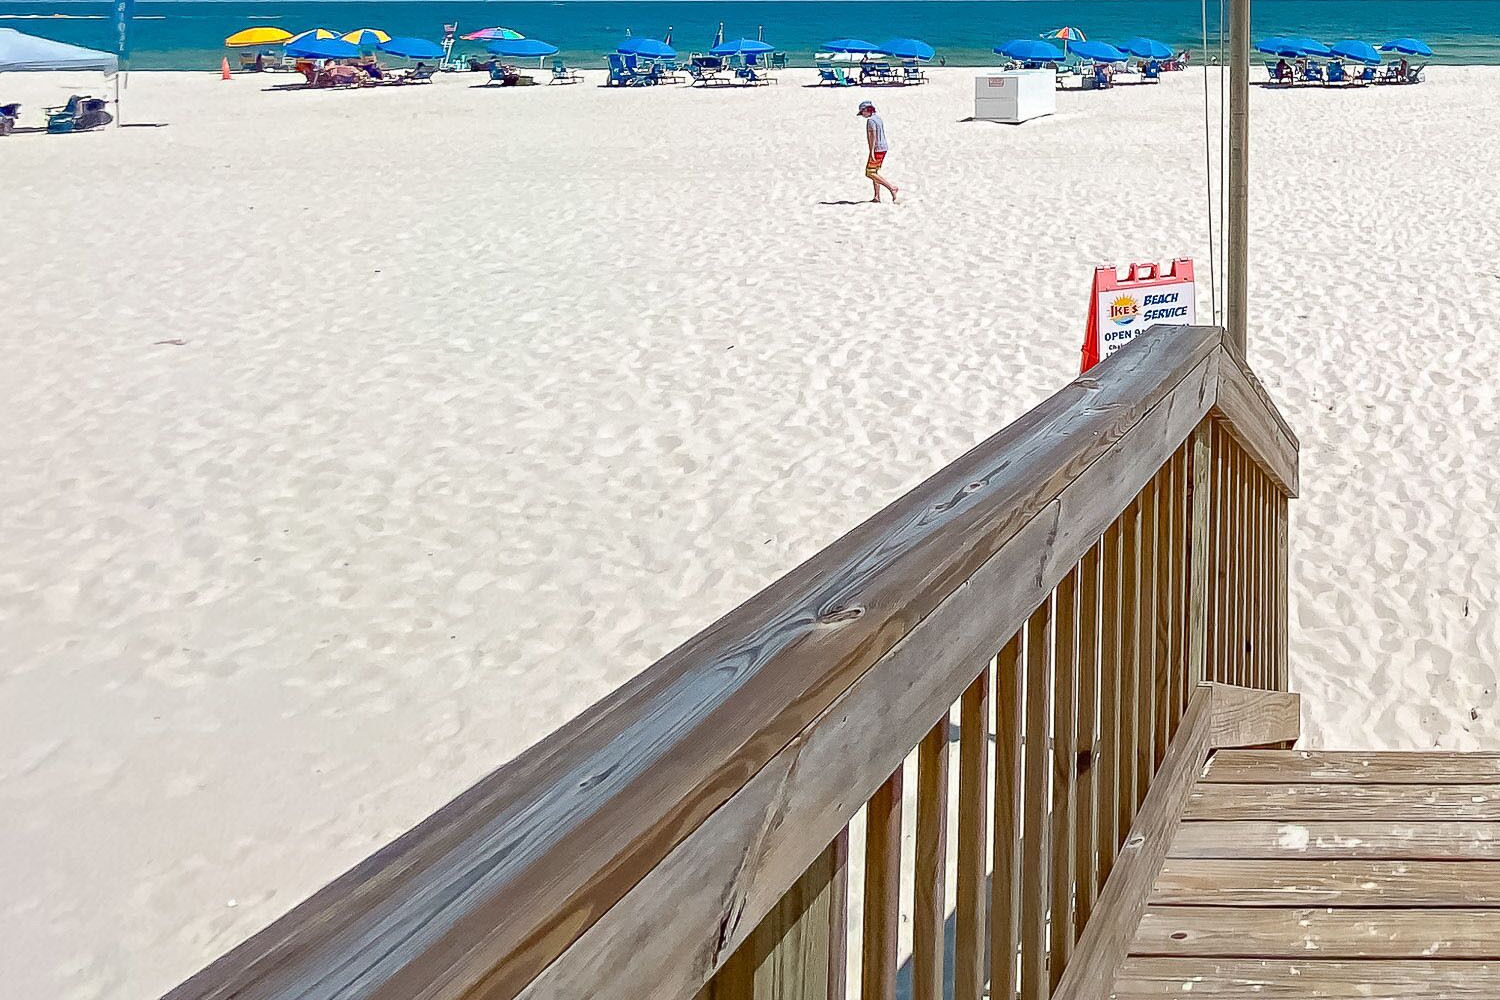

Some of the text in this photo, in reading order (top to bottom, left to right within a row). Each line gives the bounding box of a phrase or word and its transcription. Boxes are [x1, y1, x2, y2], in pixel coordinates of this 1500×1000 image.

[1143, 293, 1179, 306] BEACH
[1144, 306, 1188, 321] SERVICE
[1104, 330, 1132, 341] OPEN
